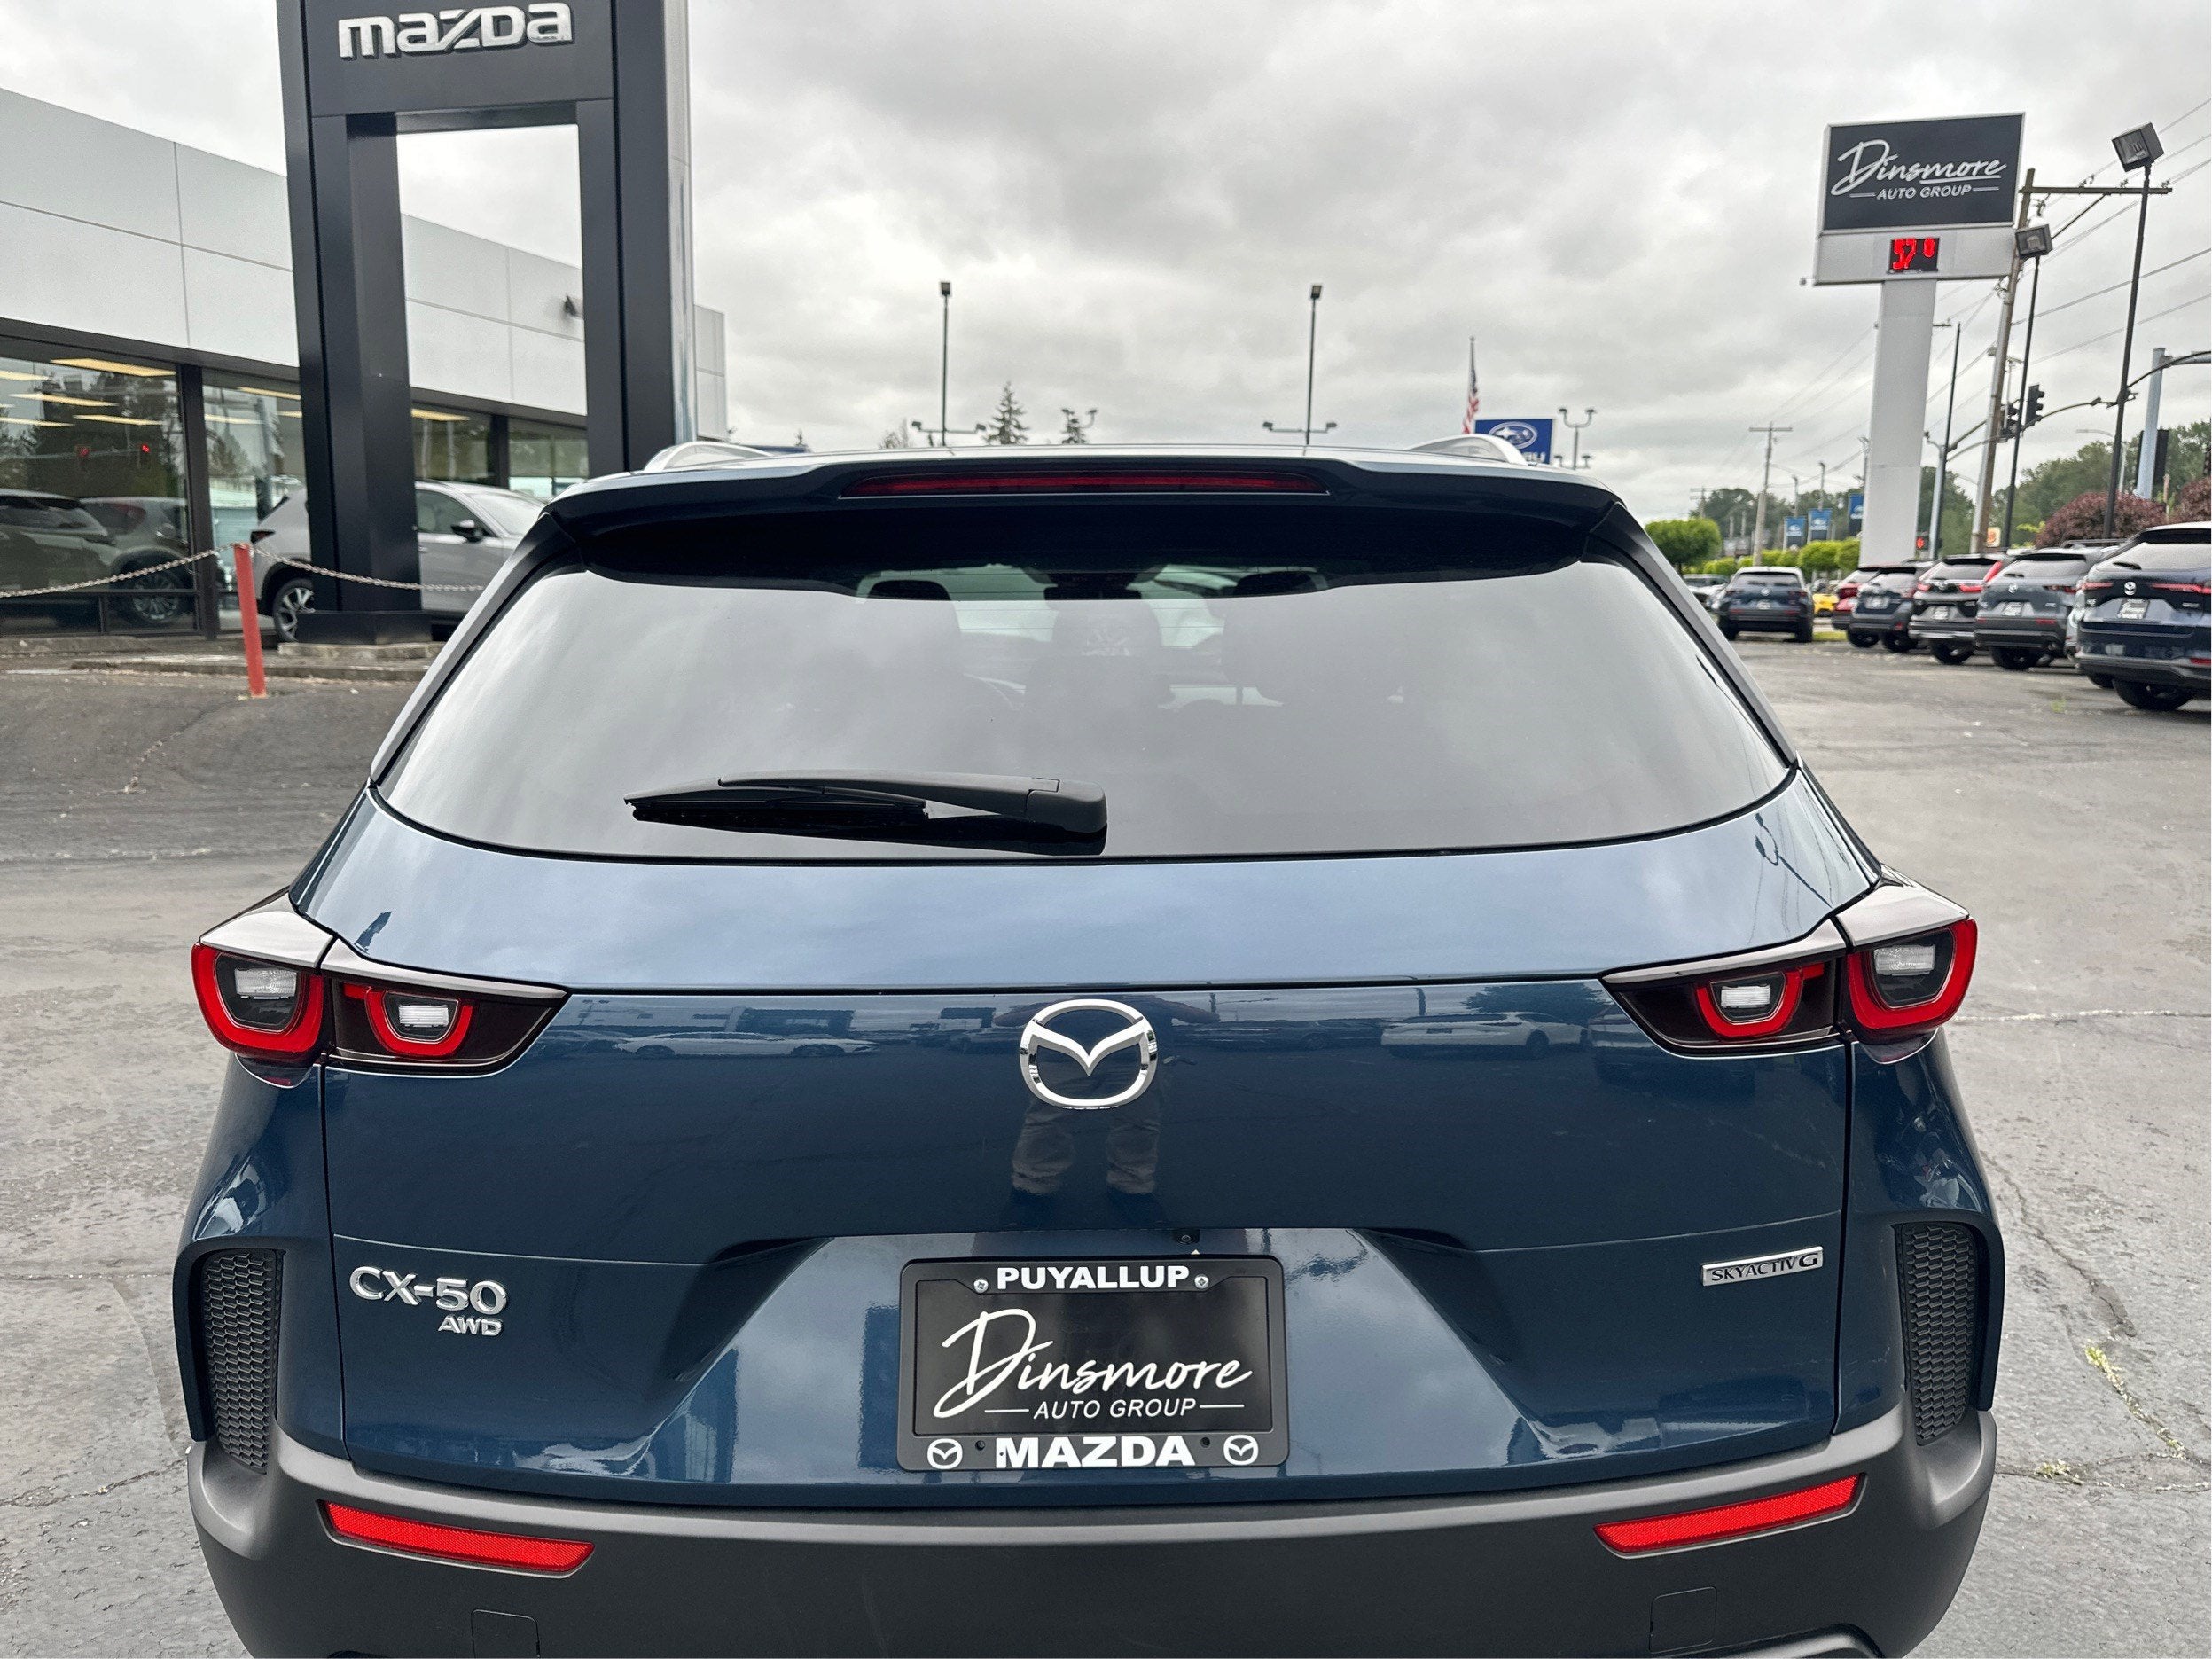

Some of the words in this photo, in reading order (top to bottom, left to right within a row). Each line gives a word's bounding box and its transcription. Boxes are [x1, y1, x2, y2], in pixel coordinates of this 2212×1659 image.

[1830, 139, 2007, 196] Dinsmore
[1876, 187, 1917, 200] AUTO
[1919, 184, 1972, 198] GROUP
[349, 1265, 507, 1315] CX-50
[997, 1265, 1190, 1290] PUYALLUP
[437, 1314, 503, 1336] AWD
[933, 1308, 1253, 1419] Dinsmore
[1033, 1400, 1101, 1419] AUTO
[1108, 1398, 1197, 1418] GROUP
[996, 1435, 1196, 1469] MAZDA
